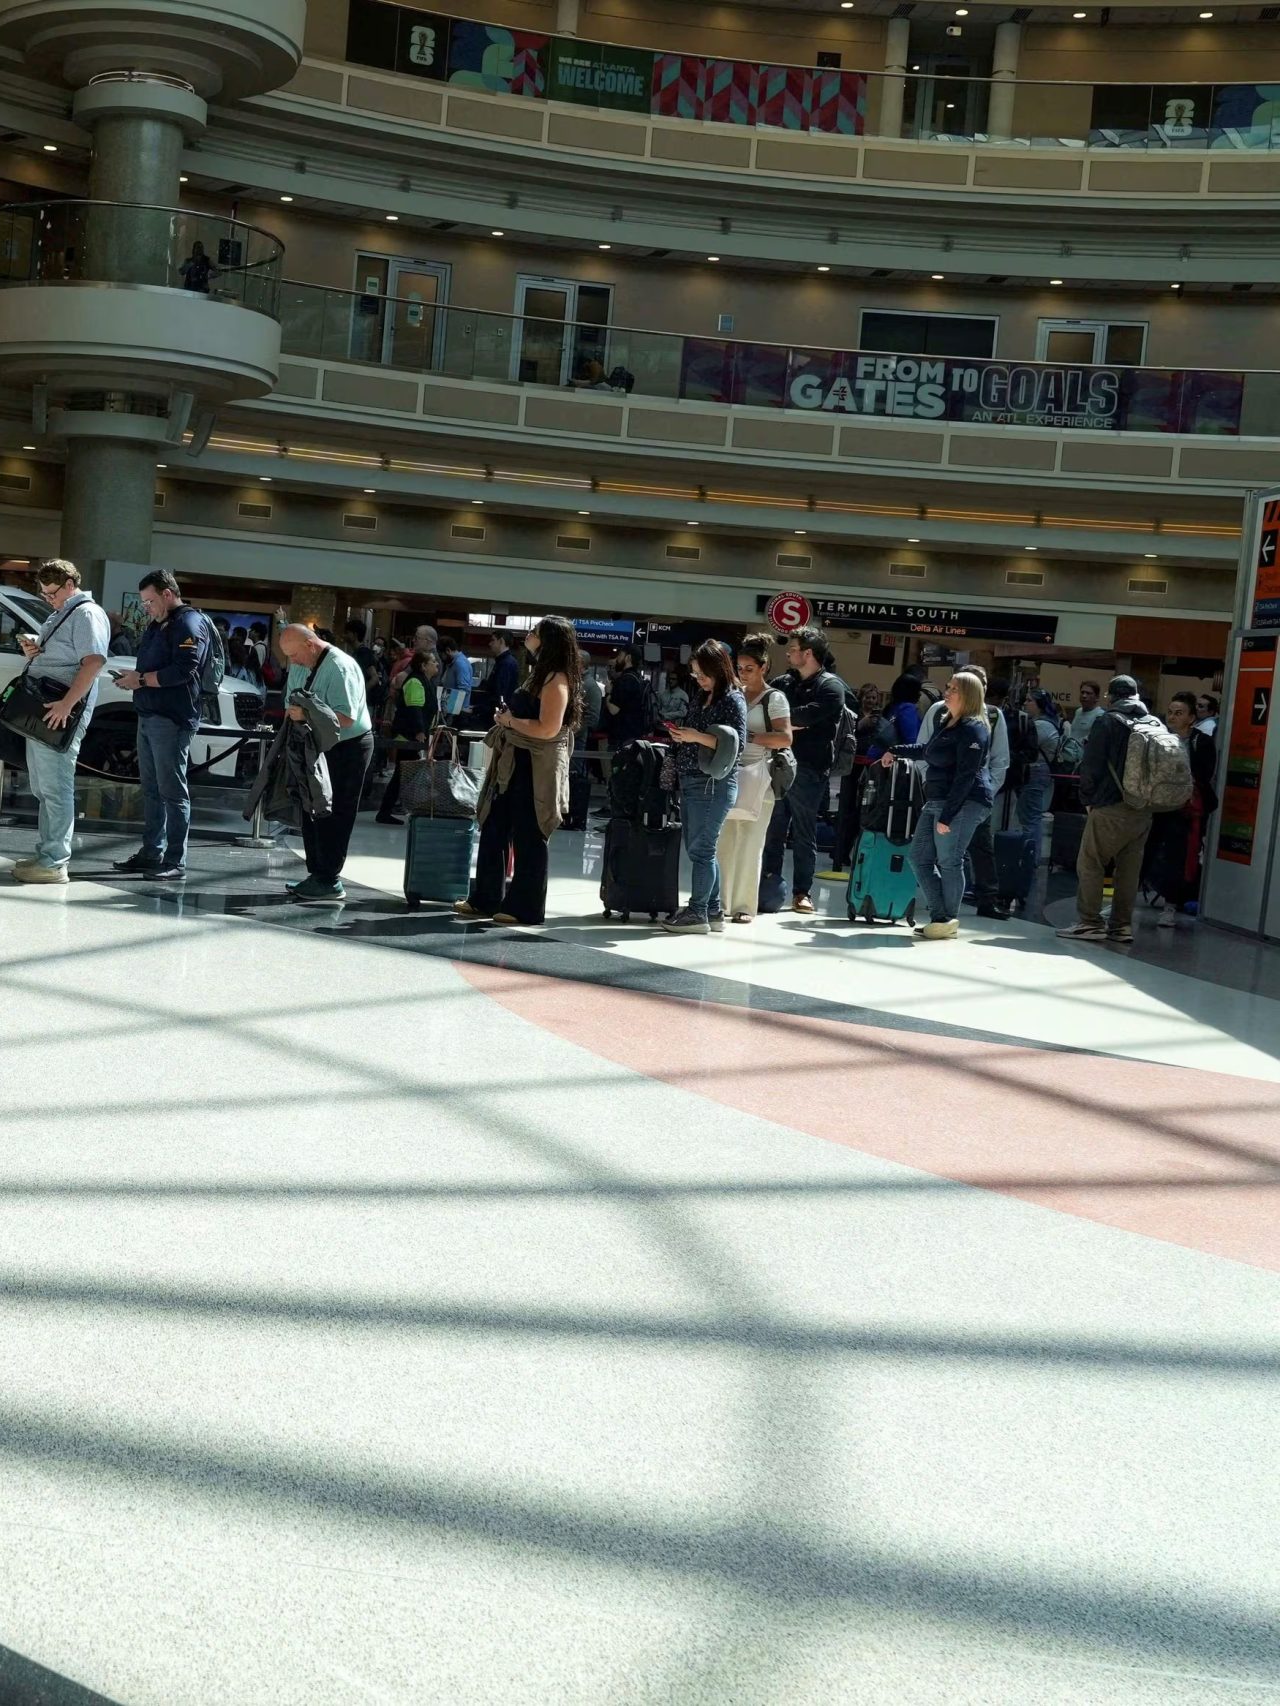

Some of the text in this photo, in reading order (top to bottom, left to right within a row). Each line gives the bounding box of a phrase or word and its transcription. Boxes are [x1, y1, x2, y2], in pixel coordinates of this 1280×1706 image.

[558, 56, 572, 64] WE
[592, 62, 636, 73] ATLANTA
[558, 64, 644, 97] WELCOME
[856, 356, 945, 384] FROM
[789, 374, 947, 419] GATES
[951, 365, 1120, 417] TO GOALS
[971, 411, 1113, 429] AN ATL EXPERIENCE
[780, 600, 801, 626] S
[816, 600, 960, 621] TERMINAL SOUTH
[620, 634, 630, 642] Pre
[658, 624, 671, 632] KCM
[910, 622, 966, 636] Delta Air Lines
